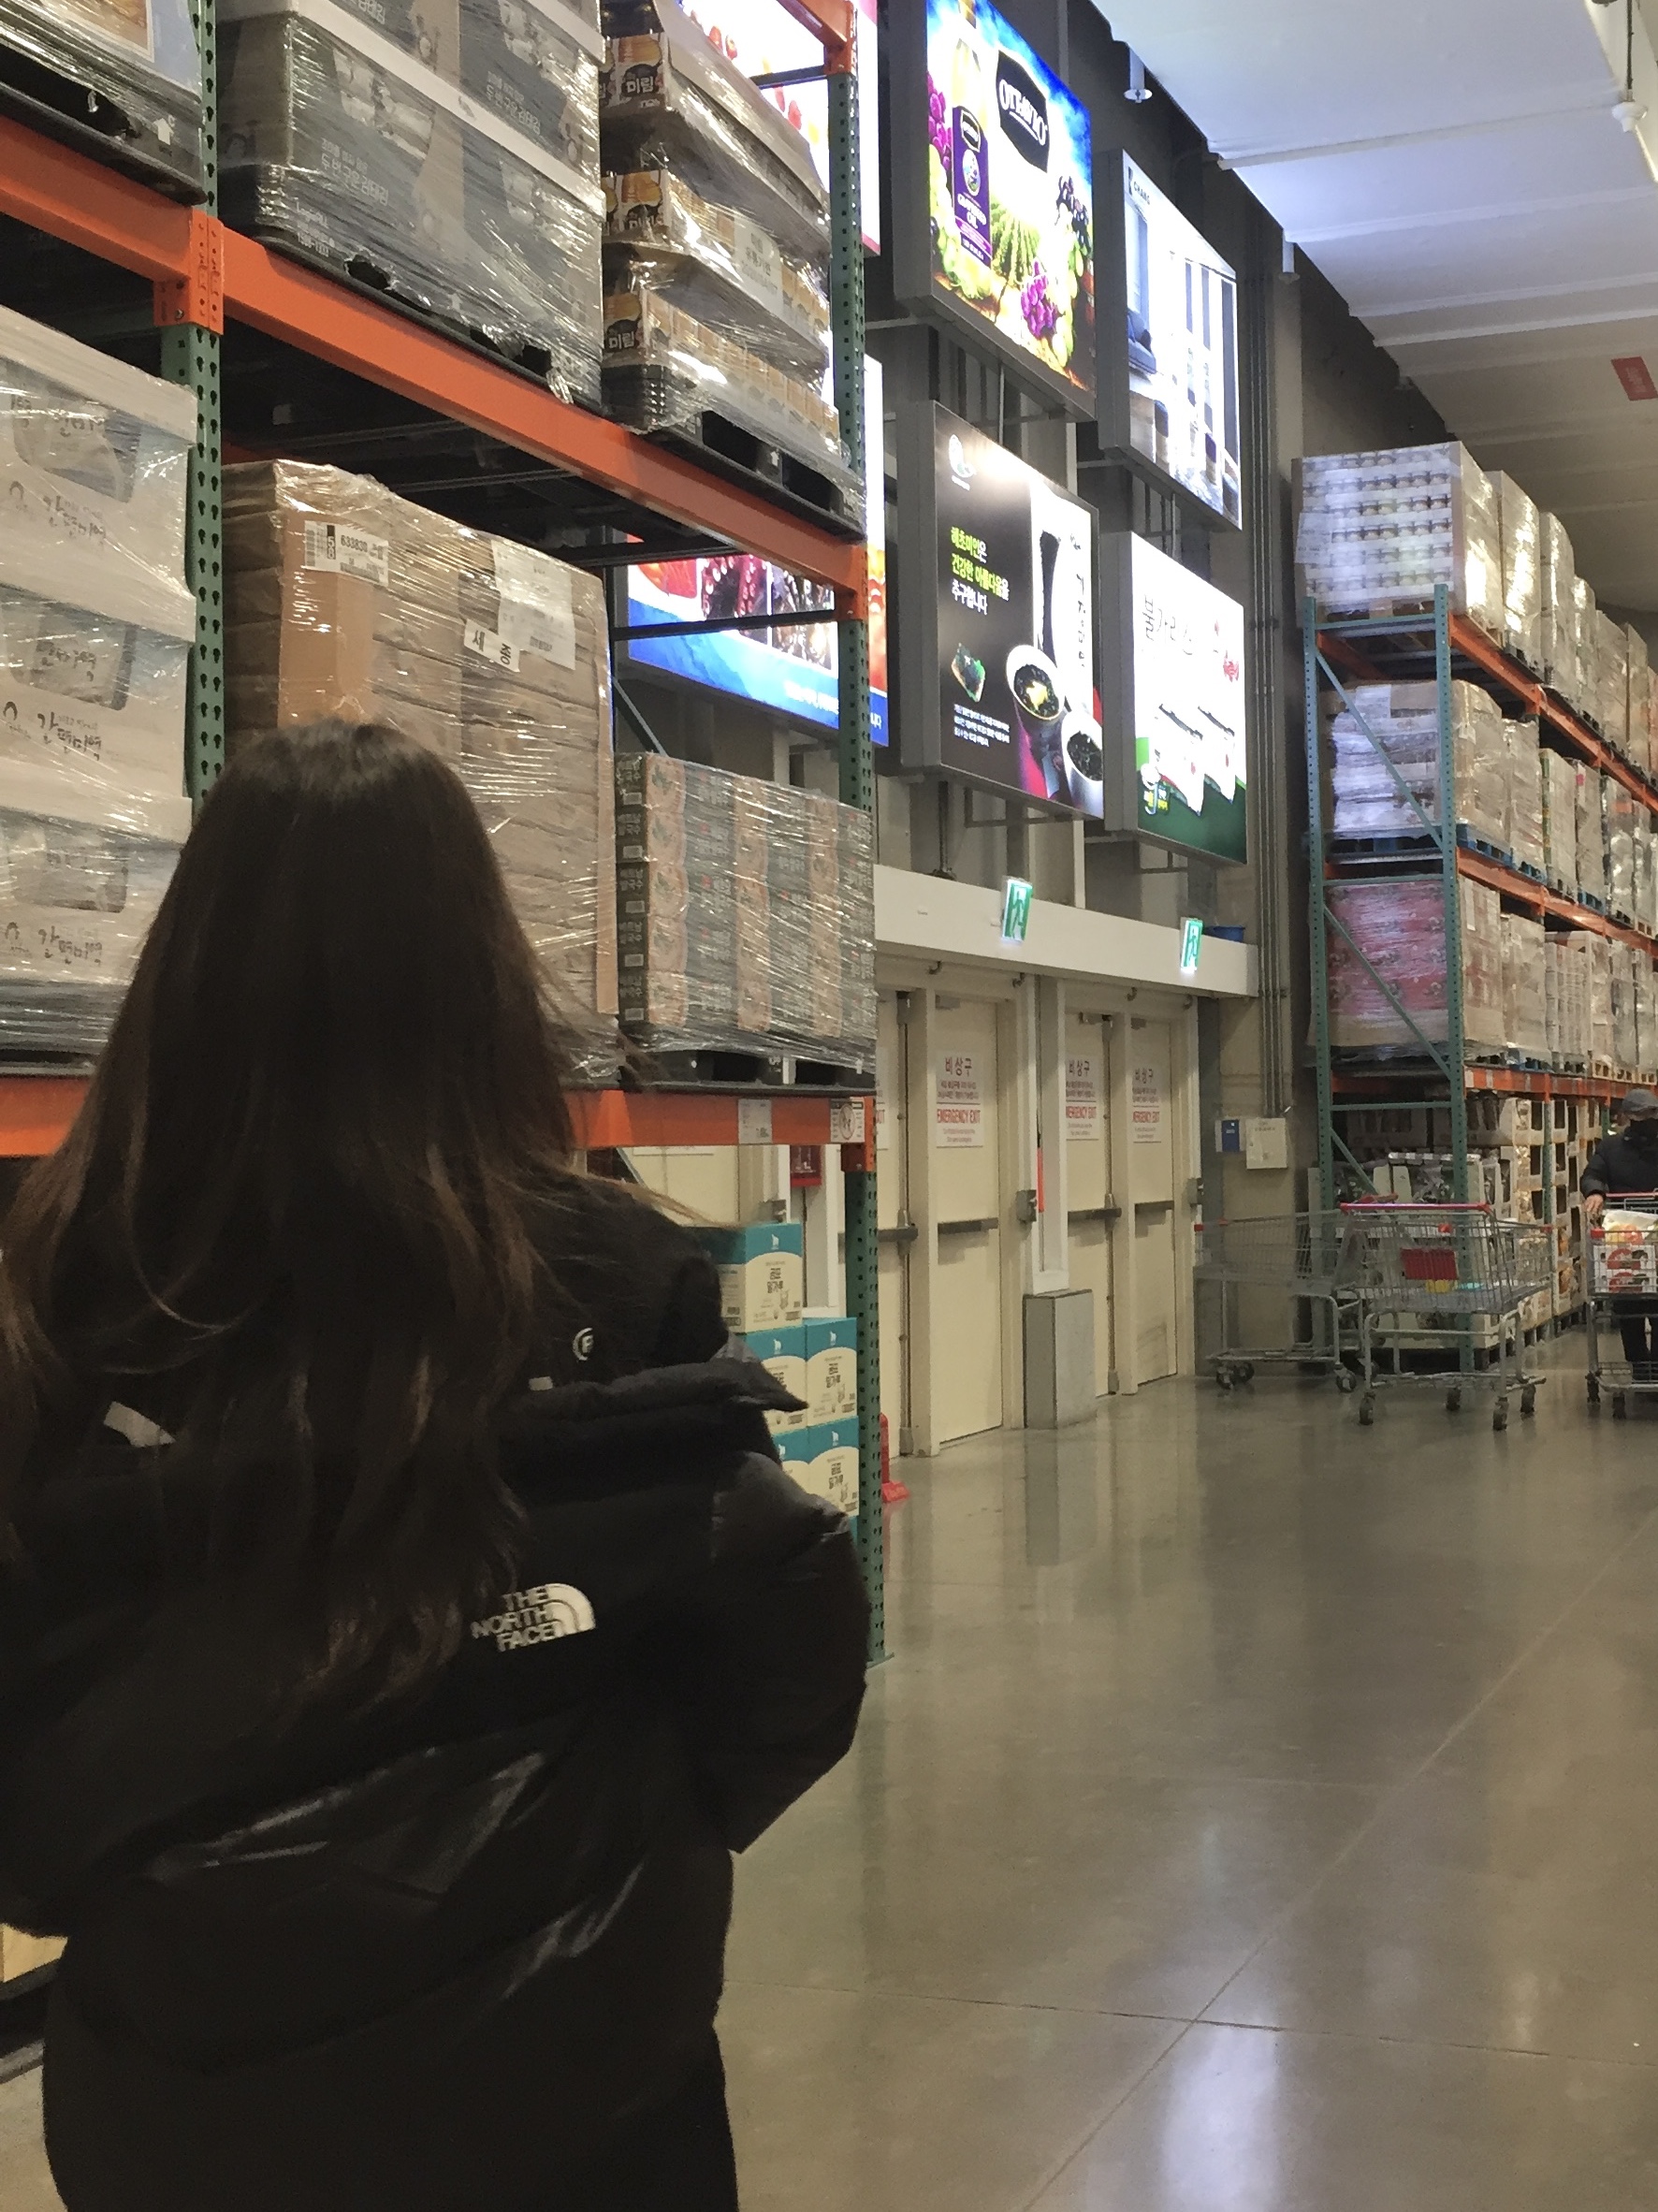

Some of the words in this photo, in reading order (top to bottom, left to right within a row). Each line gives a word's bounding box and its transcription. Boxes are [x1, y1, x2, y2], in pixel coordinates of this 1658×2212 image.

[626, 76, 654, 94] 미림
[608, 331, 635, 350] 미림
[952, 553, 974, 583] 건강한
[975, 565, 1011, 602] 아름다움을
[945, 1056, 972, 1077] 비상구
[1069, 1059, 1090, 1077] 비상구
[1134, 1068, 1154, 1084] 비상구
[937, 1109, 968, 1124] EMERGENCY
[969, 1109, 981, 1124] EXIT
[502, 1585, 549, 1610] THE
[470, 1606, 554, 1639] NORTH
[496, 1623, 558, 1652] FACE
